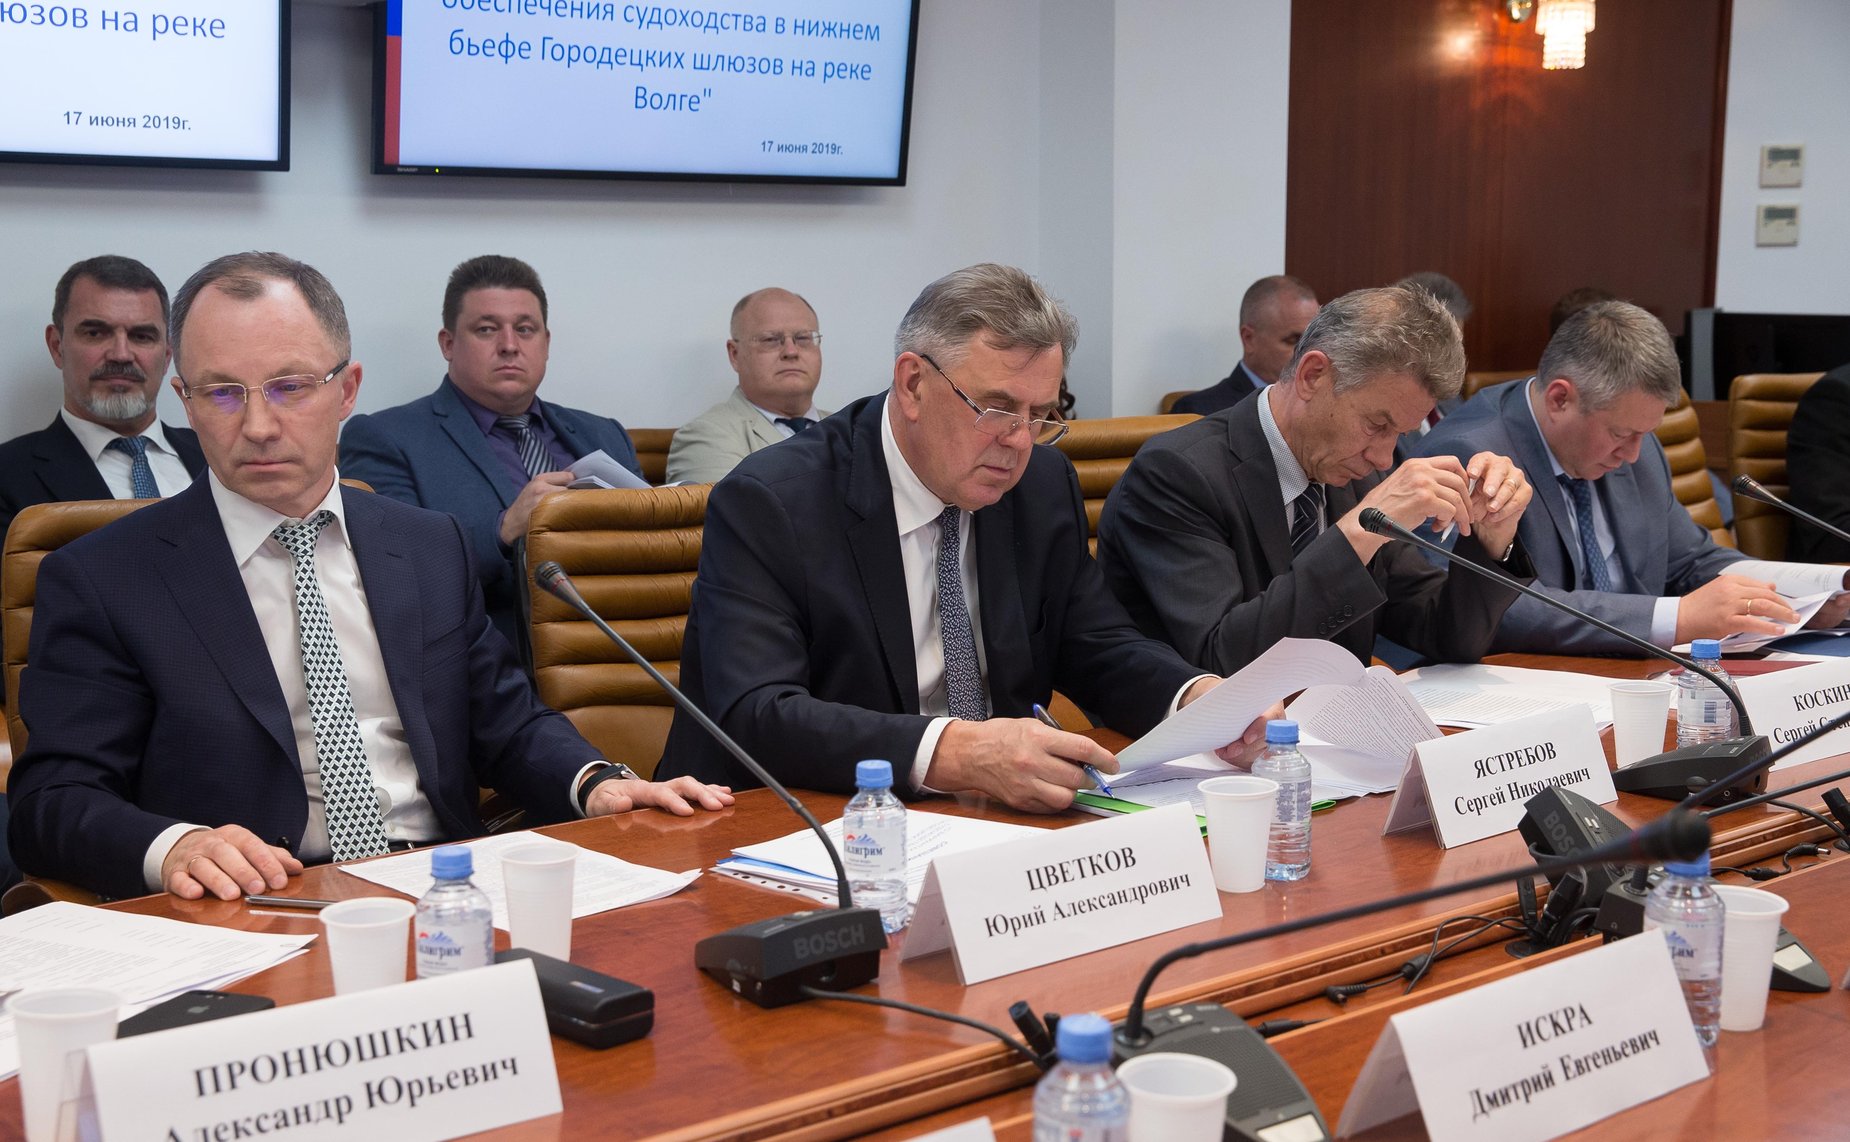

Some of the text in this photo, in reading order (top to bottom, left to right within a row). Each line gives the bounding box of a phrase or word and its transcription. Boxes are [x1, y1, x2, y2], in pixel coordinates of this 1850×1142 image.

[101, 10, 138, 32] на
[152, 13, 226, 40] реке
[623, 4, 766, 35] судоходства
[775, 17, 786, 34] в
[793, 18, 880, 41] нижнем
[450, 29, 872, 83] бьефе Городецких шлюзов на реке
[634, 86, 712, 112] Волге"
[63, 111, 191, 130] 17 июня 2019г.
[761, 141, 843, 155] 17 июня 2019г.
[1773, 720, 1817, 744] Сергей
[1474, 742, 1557, 778] ЯСТРЕБОВ
[1454, 786, 1506, 816] Сергей
[1026, 847, 1137, 892] ЦВЕТКОВ
[984, 873, 1192, 938] Юрий Александрович
[792, 923, 866, 960] BOSCH
[1517, 1002, 1593, 1049] ИСКРА
[194, 1011, 475, 1098] ПРОНЮШКИН
[364, 1057, 520, 1110] Юрьевич
[1469, 1028, 1661, 1123] Дмитрий Евгеньевич
